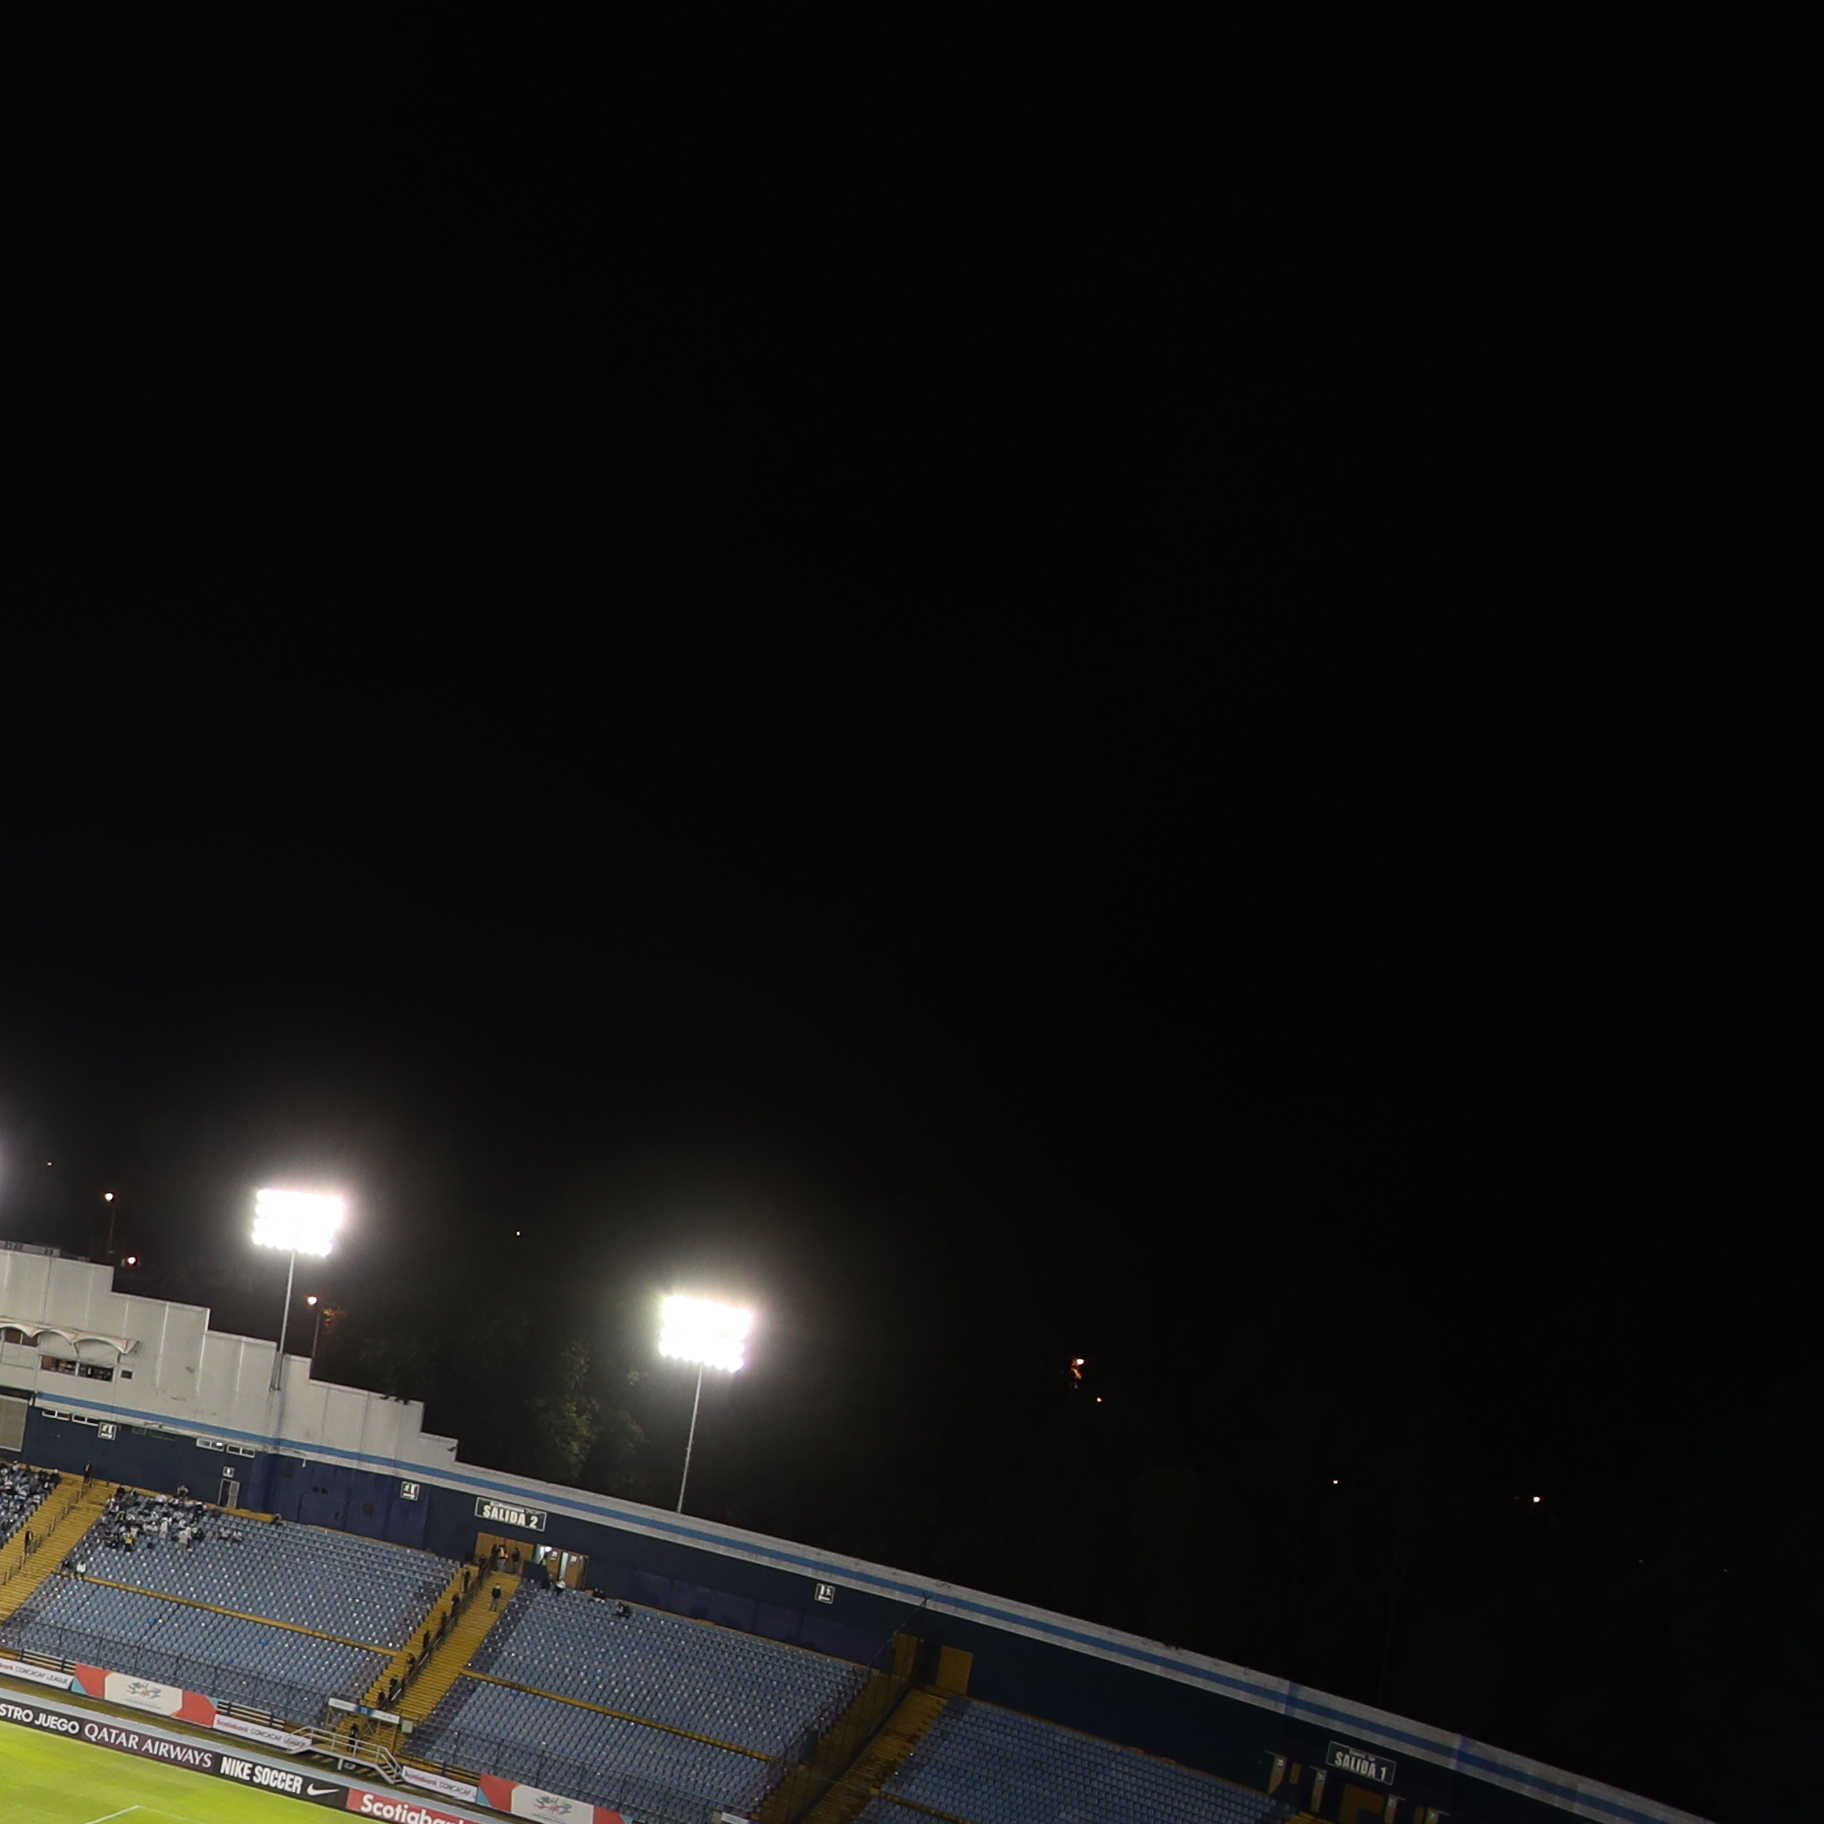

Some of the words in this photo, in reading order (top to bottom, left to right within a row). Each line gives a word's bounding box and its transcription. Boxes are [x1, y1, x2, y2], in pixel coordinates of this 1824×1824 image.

[482, 1503, 527, 1526] SALIDA
[529, 1515, 539, 1528] 2
[34, 1710, 80, 1735] JUEGO
[84, 1723, 139, 1750] QATAR
[141, 1738, 213, 1768] AIRWAYS
[220, 1756, 253, 1781] NIKE
[253, 1765, 304, 1794] SOCCER
[404, 1769, 438, 1786] Scotiabank
[1333, 1751, 1376, 1778] SALIDA
[1379, 1766, 1386, 1780] 1
